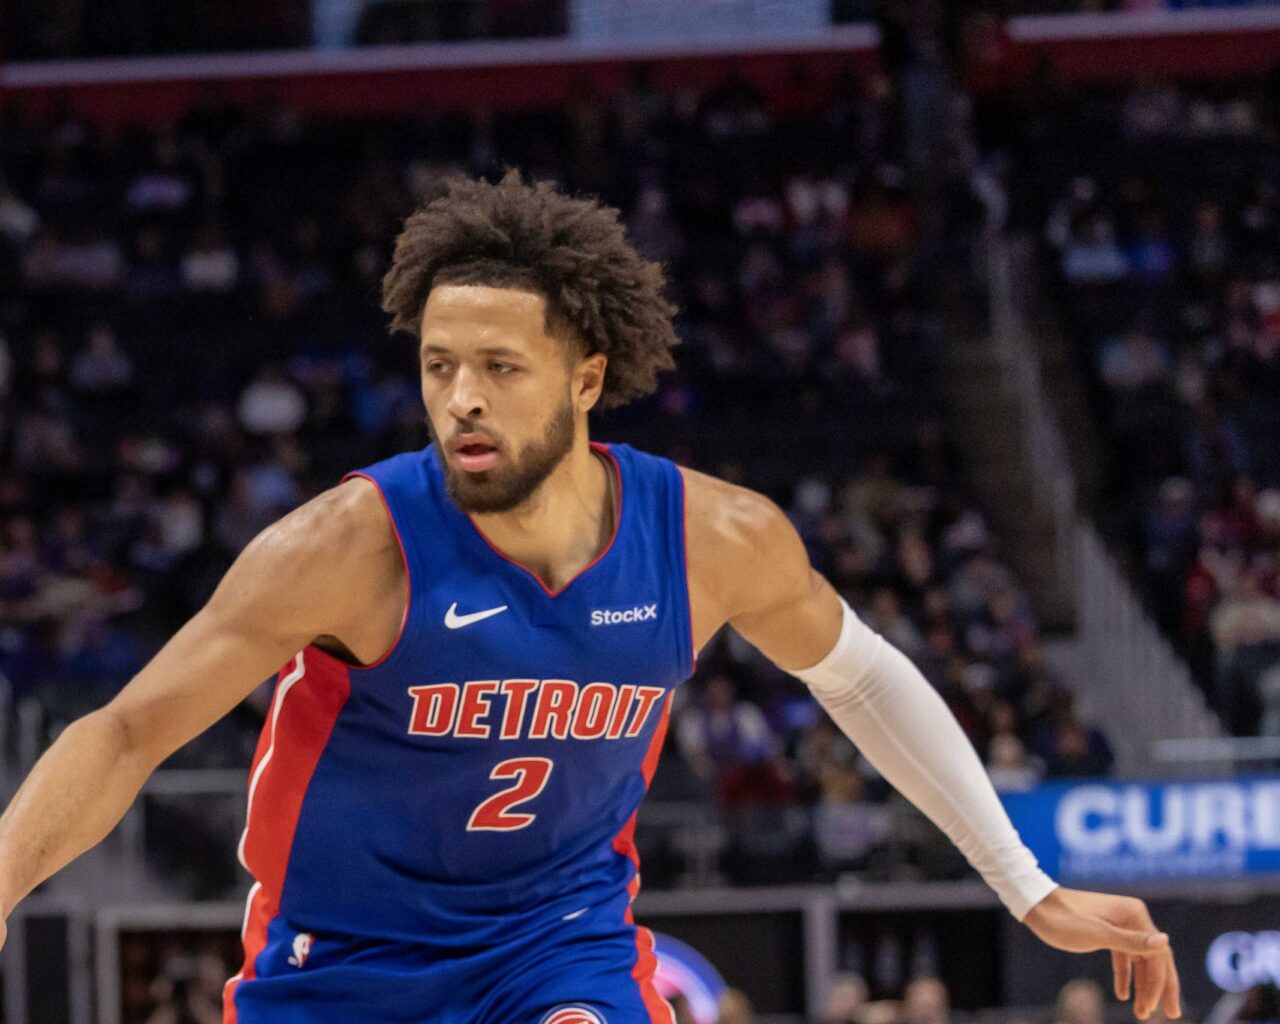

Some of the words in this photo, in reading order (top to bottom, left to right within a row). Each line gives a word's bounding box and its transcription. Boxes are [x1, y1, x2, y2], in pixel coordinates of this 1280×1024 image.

[591, 603, 658, 625] StockX
[408, 678, 665, 740] DETROIT
[466, 757, 553, 832] 2
